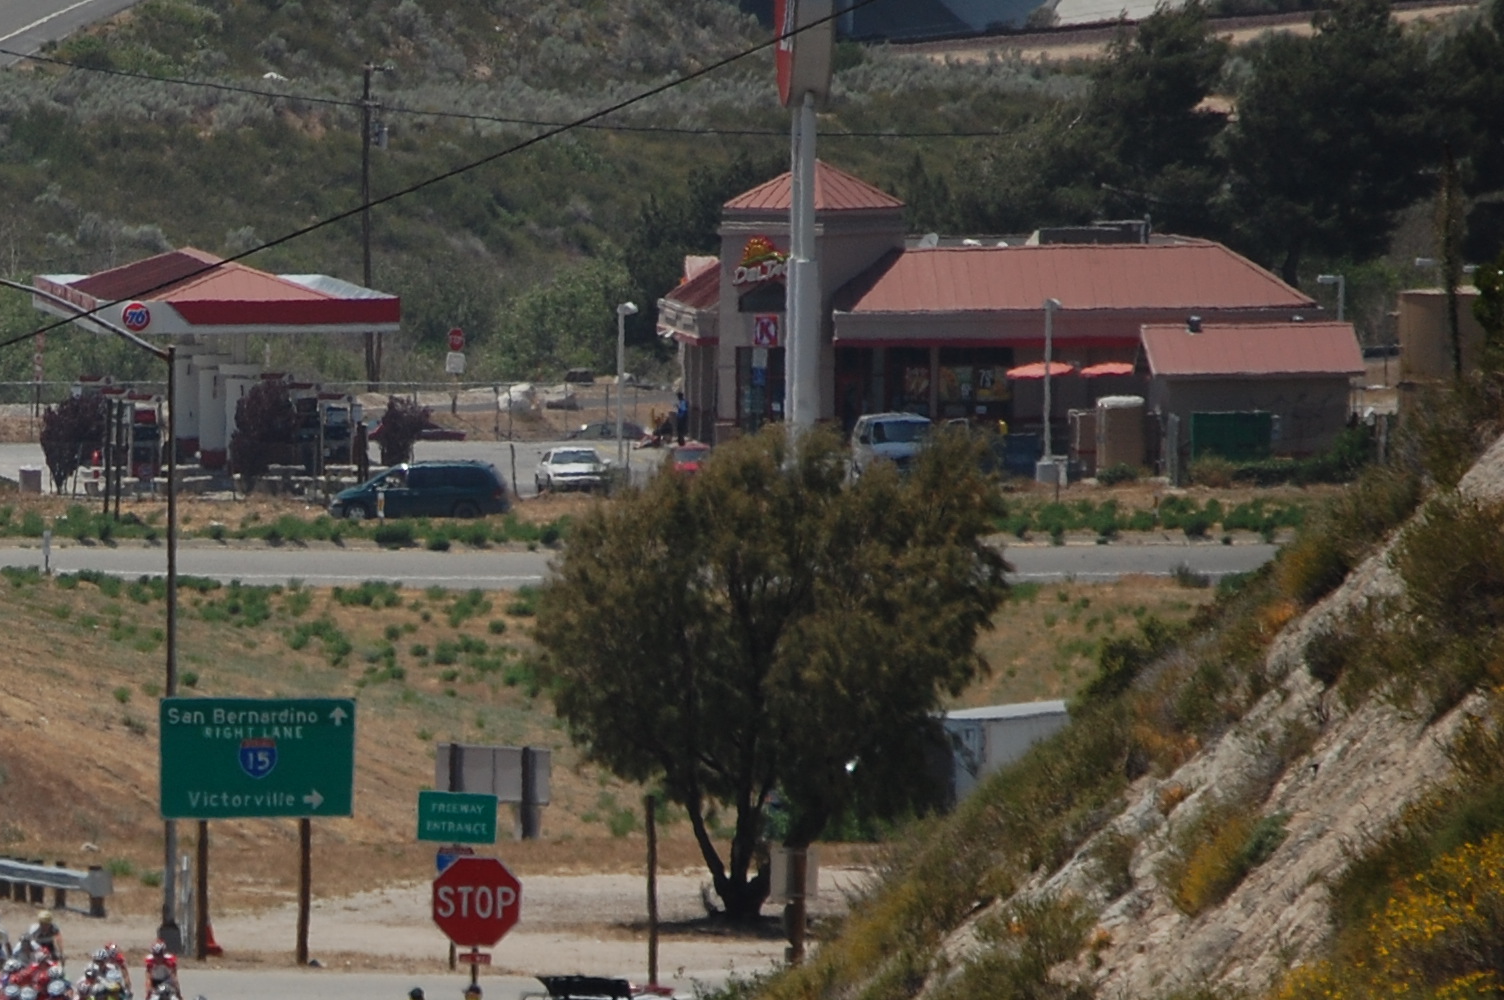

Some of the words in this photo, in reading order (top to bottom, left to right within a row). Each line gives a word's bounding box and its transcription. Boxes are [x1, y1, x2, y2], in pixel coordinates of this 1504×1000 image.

[126, 309, 147, 324] 76
[168, 708, 205, 724] San
[213, 708, 318, 724] Bernardino
[204, 726, 253, 739] RIGHT
[262, 726, 303, 739] LANE
[247, 751, 270, 770] 15
[188, 791, 295, 807] Victorville
[431, 803, 485, 814] FREEWAY
[426, 821, 488, 834] ENTRANCE
[437, 885, 516, 919] STOP
